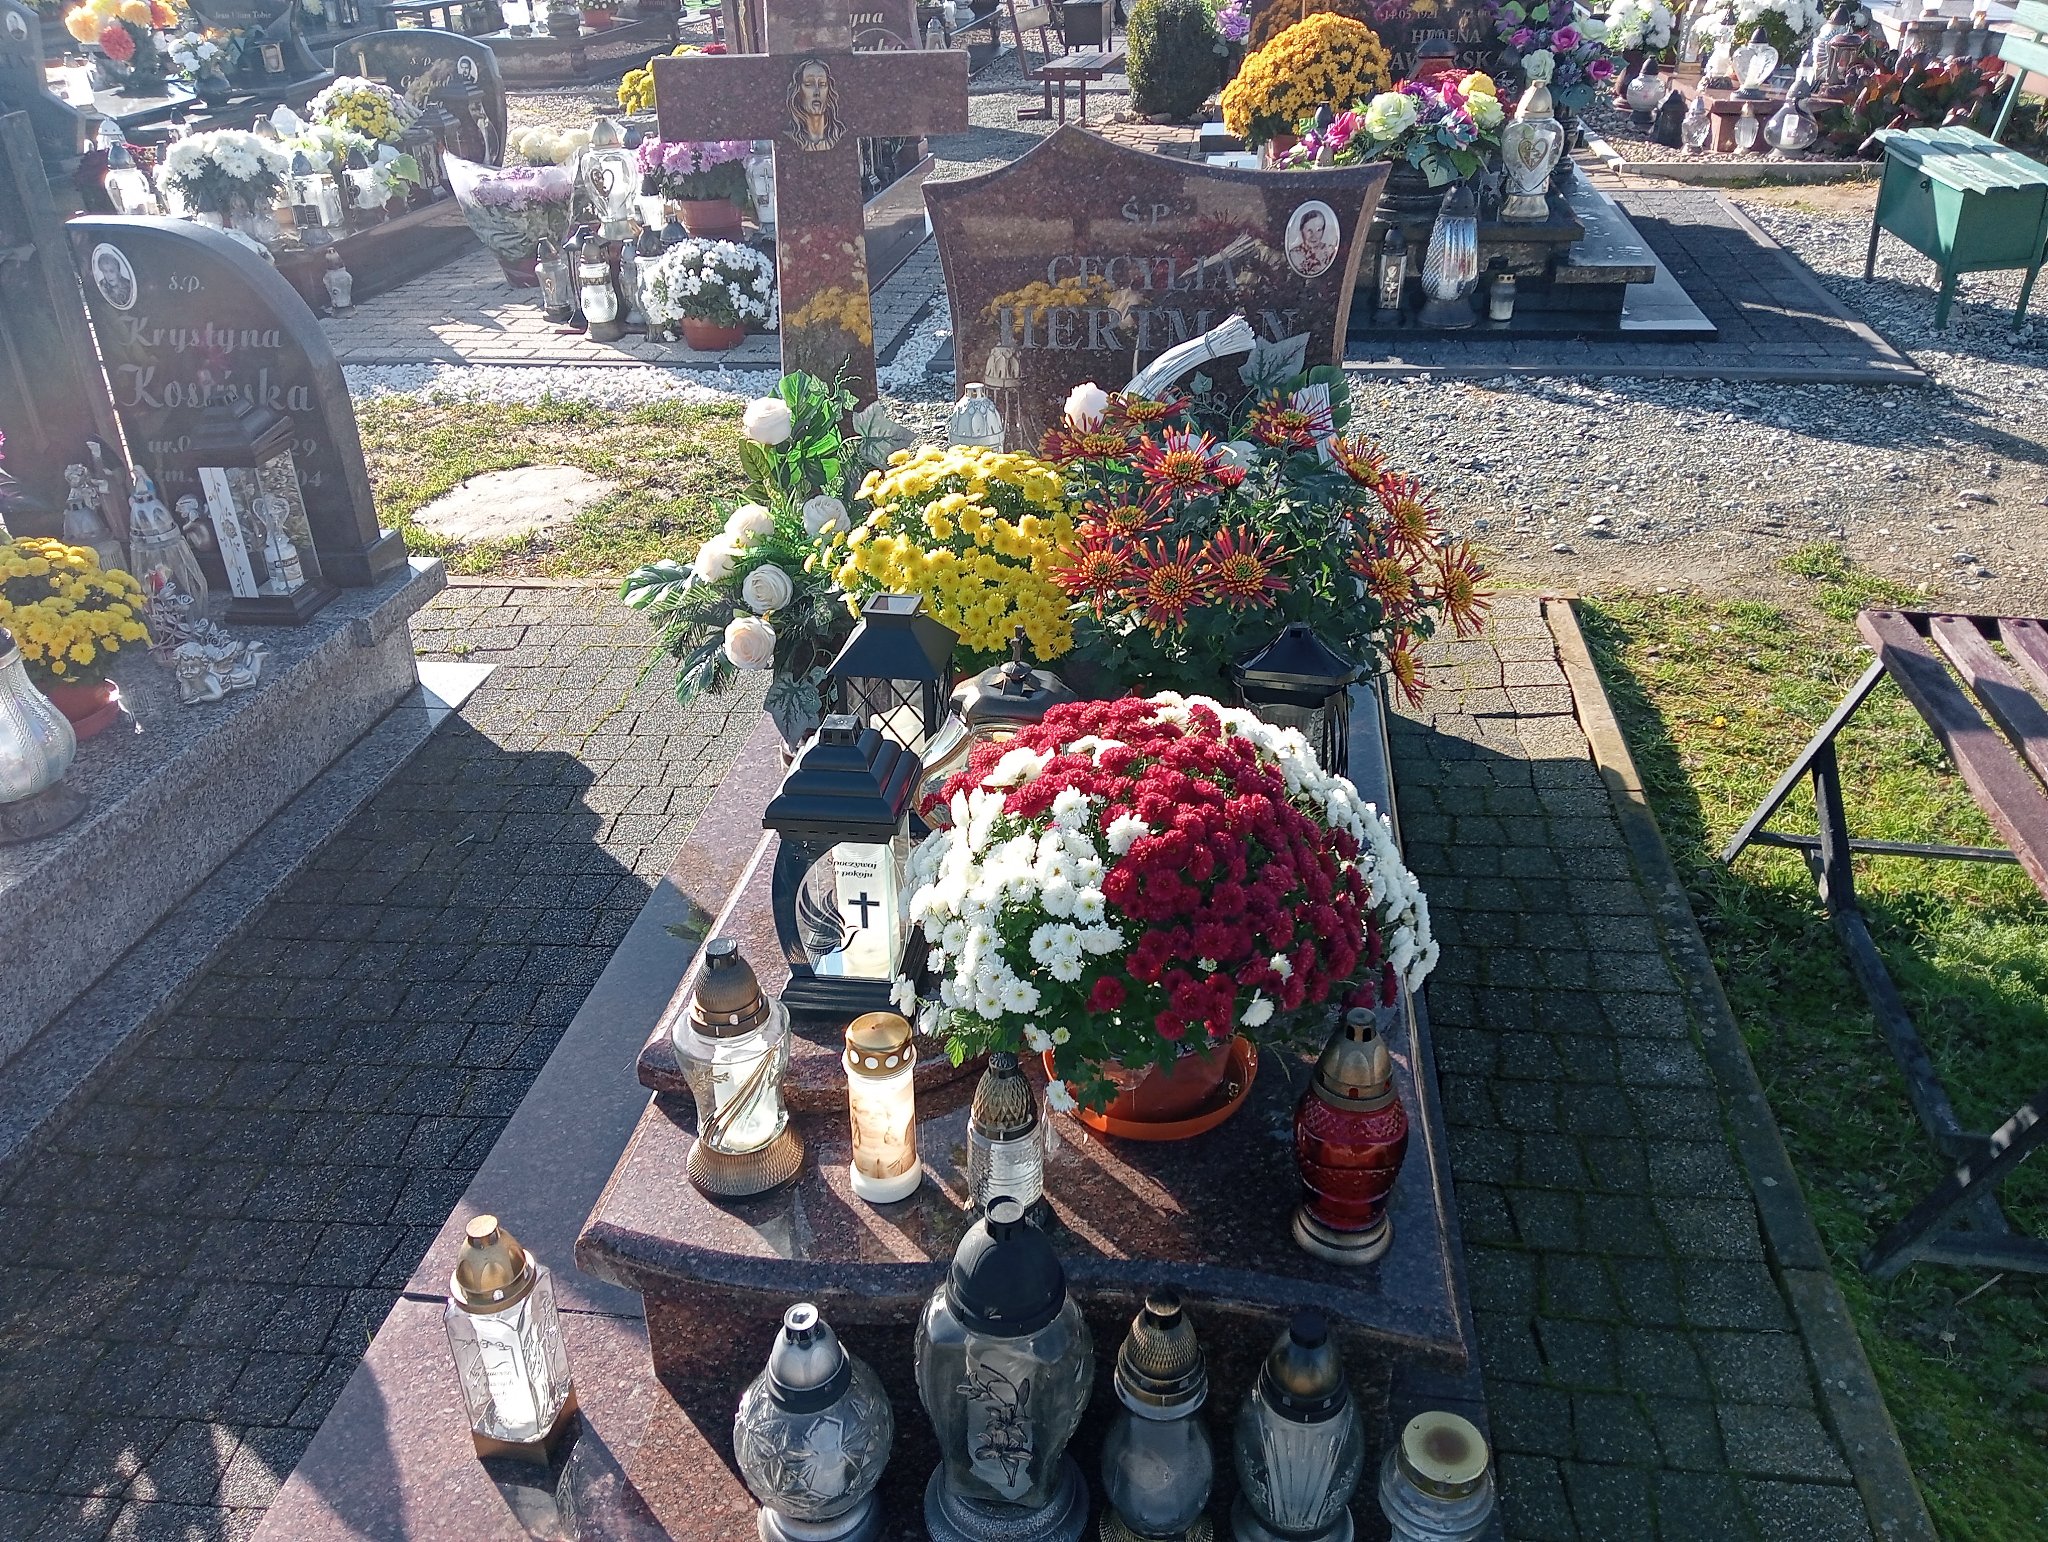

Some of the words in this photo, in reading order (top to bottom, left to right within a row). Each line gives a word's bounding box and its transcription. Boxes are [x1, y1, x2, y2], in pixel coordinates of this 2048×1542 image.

[1047, 256, 1238, 292] CECYLIA
[118, 315, 283, 354] Krystyna
[997, 307, 1302, 352] HERTMN
[841, 870, 873, 879] pokoju
